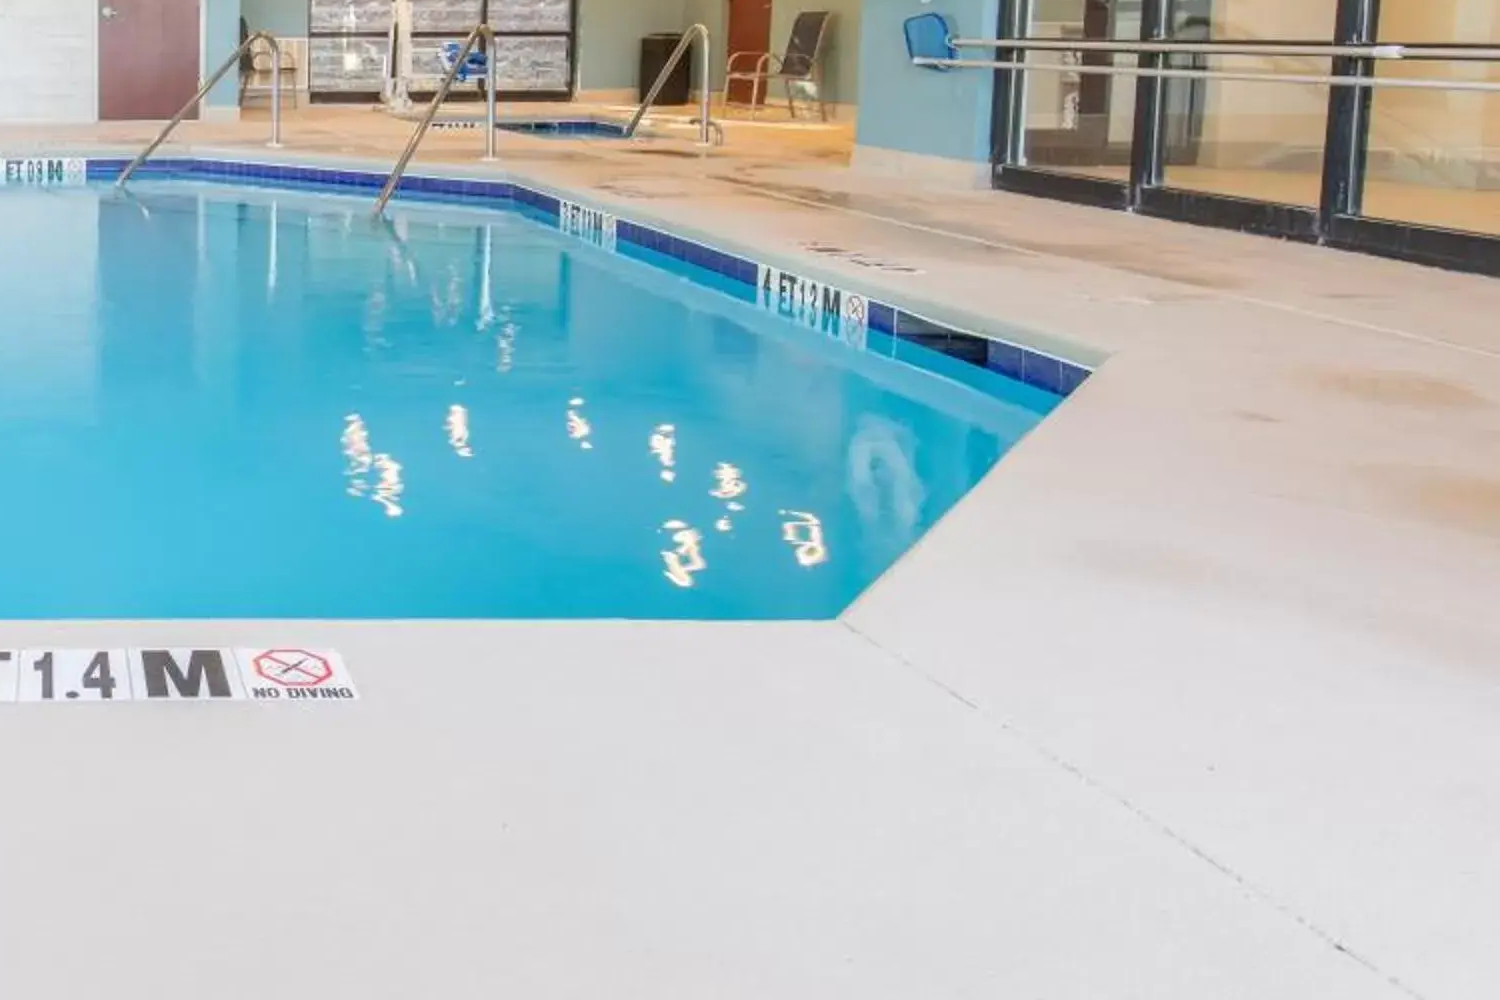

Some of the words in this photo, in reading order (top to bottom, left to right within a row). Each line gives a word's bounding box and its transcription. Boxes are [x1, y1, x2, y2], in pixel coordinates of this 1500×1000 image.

[32, 651, 117, 699] 1.4
[140, 650, 232, 698] M
[252, 688, 280, 698] NO
[286, 688, 354, 698] DIVING
